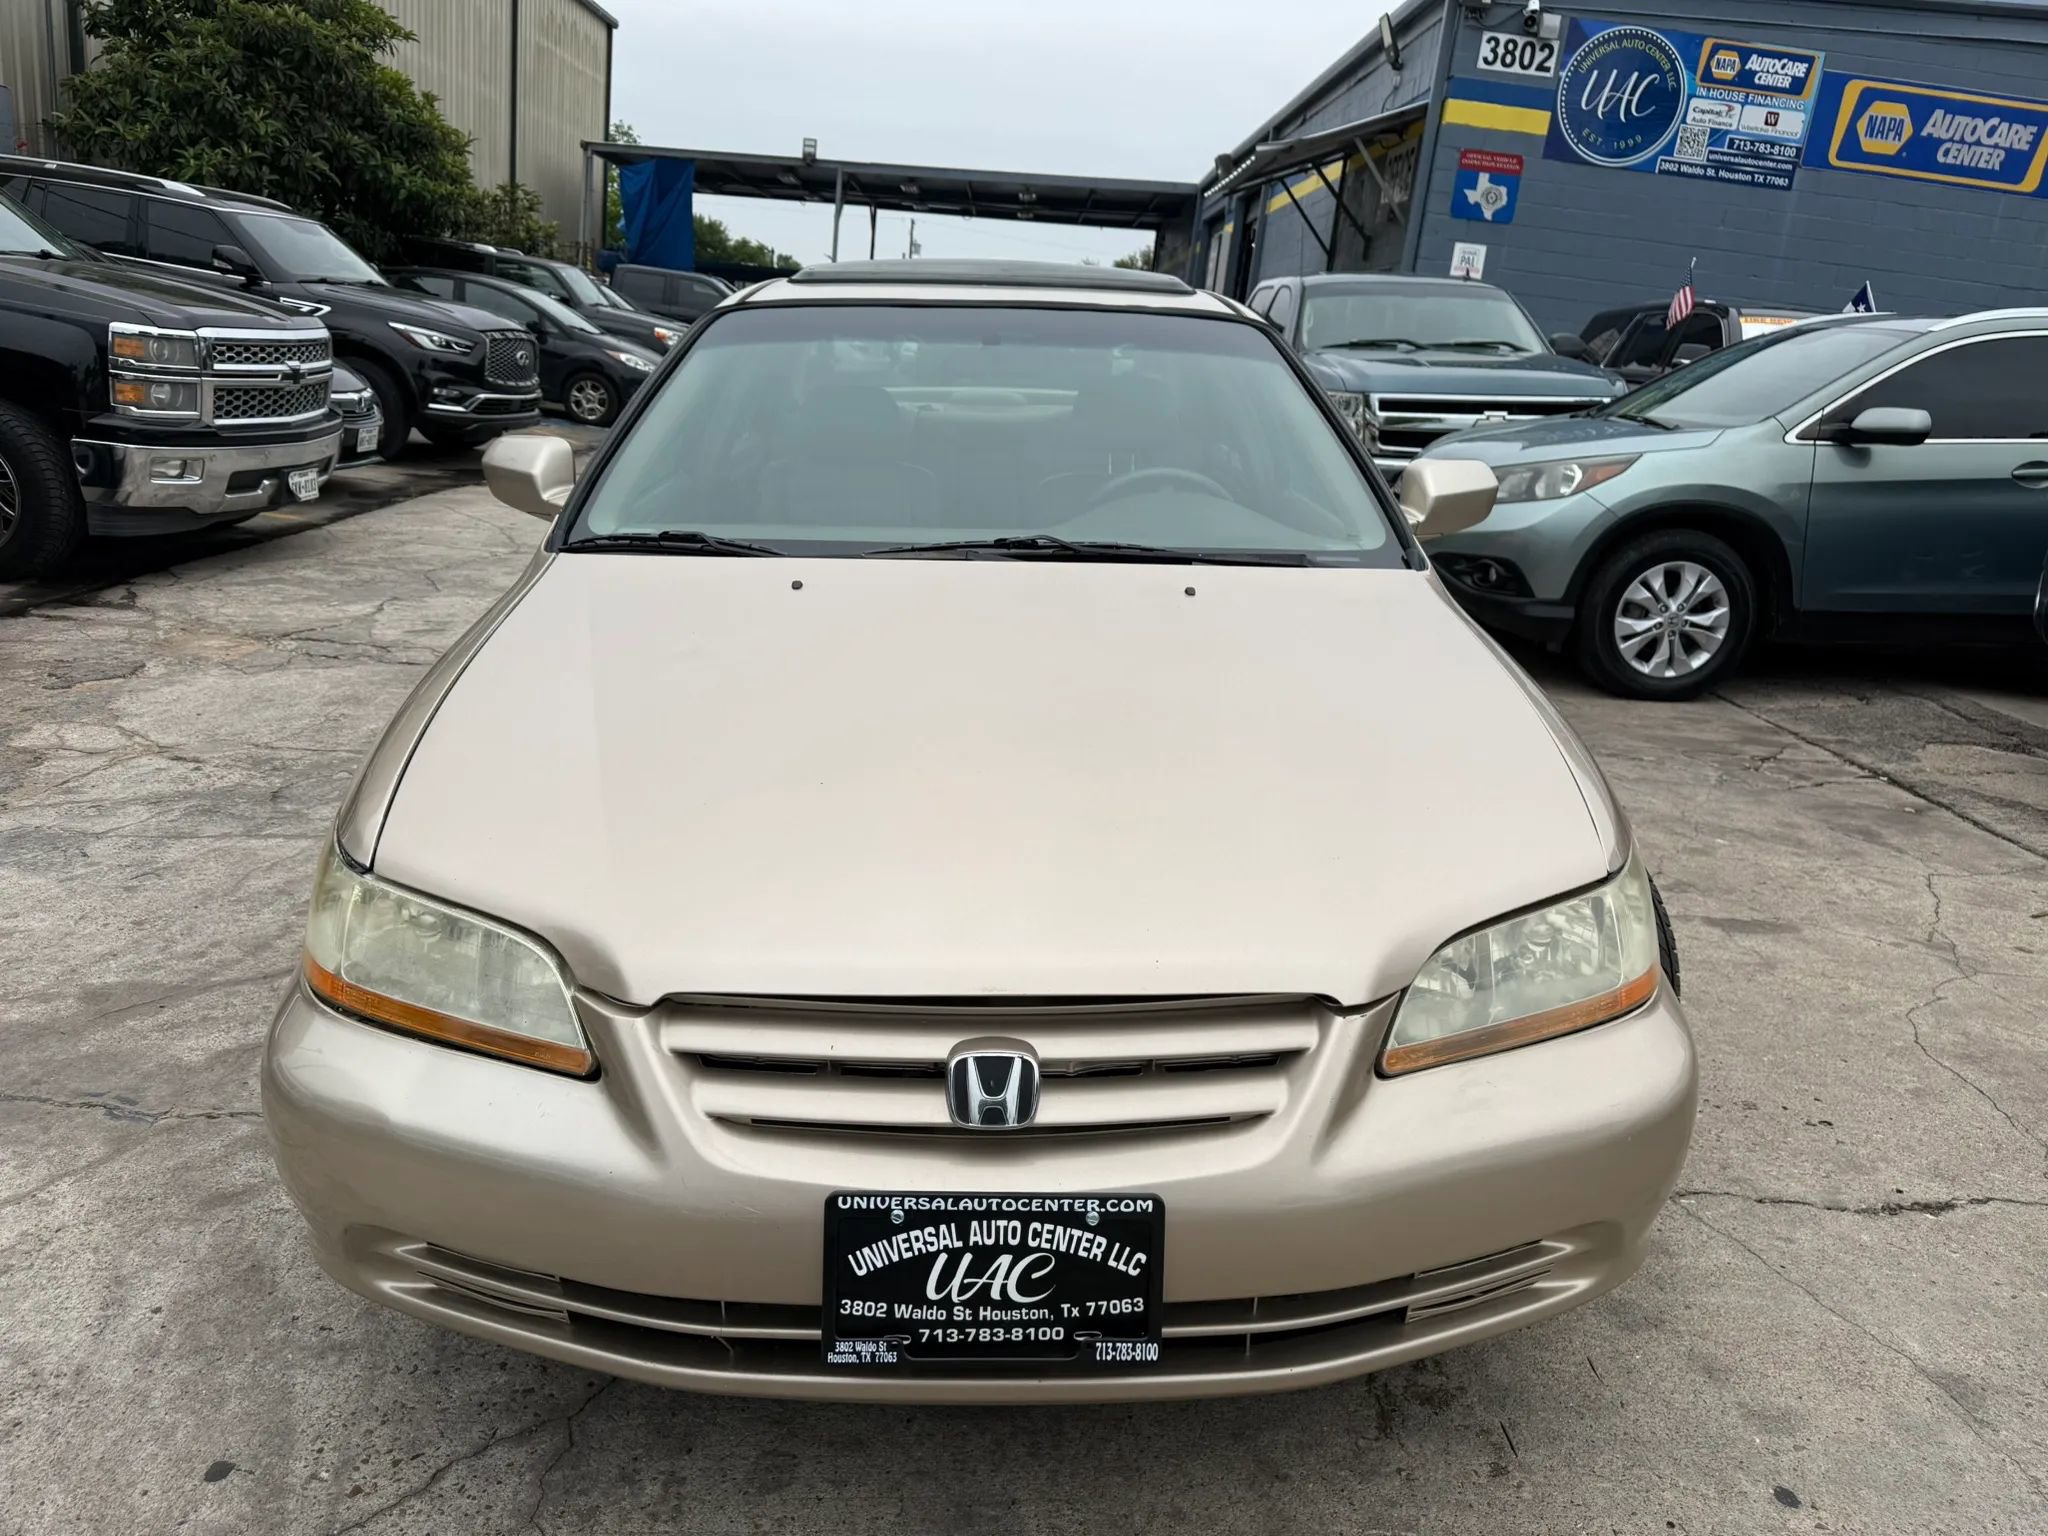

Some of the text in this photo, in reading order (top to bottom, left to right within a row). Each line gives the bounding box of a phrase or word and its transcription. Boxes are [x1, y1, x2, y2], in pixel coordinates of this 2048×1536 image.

[1482, 35, 1555, 73] 3802
[1578, 38, 1677, 92] UNIVERSAL AUTO CENTER LLC
[1714, 55, 1737, 73] NAPA
[1744, 54, 1809, 78] AUTOCARE
[1754, 72, 1793, 89] CENTER
[1580, 68, 1661, 123] UAC
[1696, 87, 1805, 110] IN HOUSE FINANCING
[1707, 118, 1733, 128] Finance
[1864, 114, 1905, 142] NAPA
[1920, 108, 2039, 151] AUTOCARE
[1732, 139, 1797, 158] 713-783-8100
[1936, 141, 2006, 172] CENTER
[1708, 152, 1793, 170] universalautocenter.com
[1660, 161, 1679, 172] 3802
[1680, 163, 1705, 175] Waldo
[1718, 170, 1752, 181] Houston
[1753, 173, 1765, 183] TX
[1765, 175, 1789, 187] 77063
[837, 1196, 1154, 1213] UNIVERSALAUTOCENTER.COM
[847, 1219, 1148, 1277] UNIVERSAL AUTO CENTER LLC
[925, 1252, 1057, 1303] UAC
[839, 1297, 1145, 1322] 3802 Waldo St Houston, Tx 77063
[918, 1326, 1065, 1343] 713-783-8100
[827, 1351, 898, 1364] Houston, TX 77063
[834, 1341, 887, 1353] 3802 Waldo St
[1095, 1342, 1159, 1362] 713-783-8100
